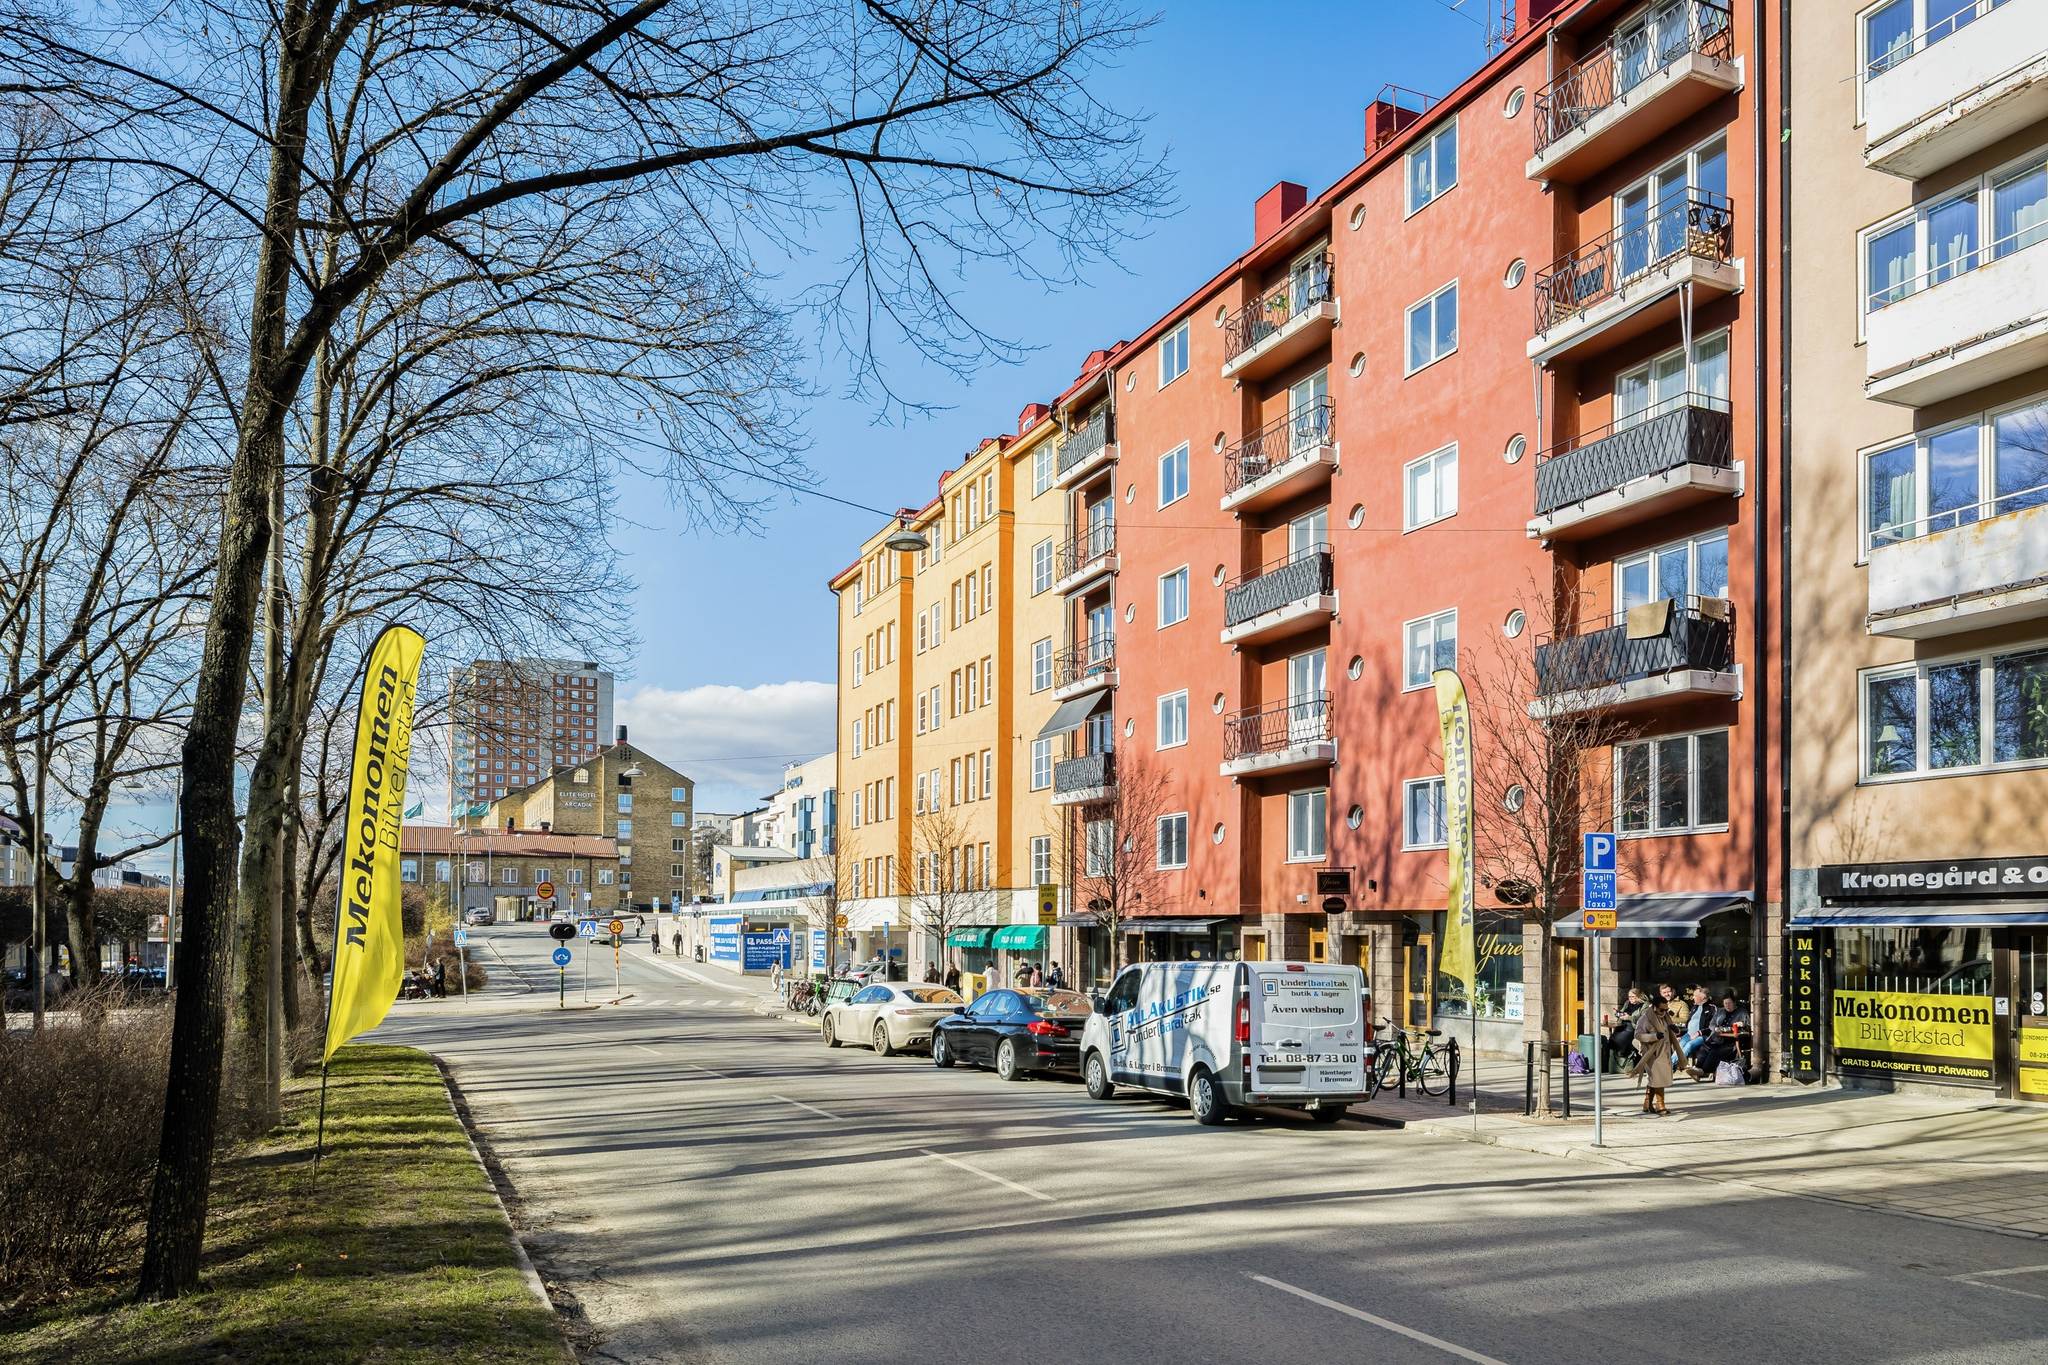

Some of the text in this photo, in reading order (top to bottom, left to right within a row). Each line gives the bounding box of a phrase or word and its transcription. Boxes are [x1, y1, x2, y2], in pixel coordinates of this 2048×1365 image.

[379, 680, 415, 852] Bilverkstad
[346, 664, 397, 952] Mekonomen
[1592, 837, 1610, 867] P
[1588, 873, 1612, 882] Avgift
[1842, 866, 1997, 890] Kronegård
[2002, 867, 2025, 885] &
[1589, 891, 1611, 899] (11-17)
[1587, 900, 1613, 908] Taxa 3
[612, 923, 621, 931] 30
[1701, 955, 1737, 968] SUSHI
[1272, 1004, 1345, 1015] Även webshop
[1797, 938, 1814, 1070] Mekonomen
[1834, 996, 1990, 1025] Mekonomen
[1860, 1022, 1965, 1047] Bilverkstad
[1128, 1060, 1134, 1069] &
[1259, 1055, 1357, 1063] Tel. 08-87 33 00
[1841, 1058, 1989, 1078] GRATIS DÄCKSKIFTE VID FÖRVARING
